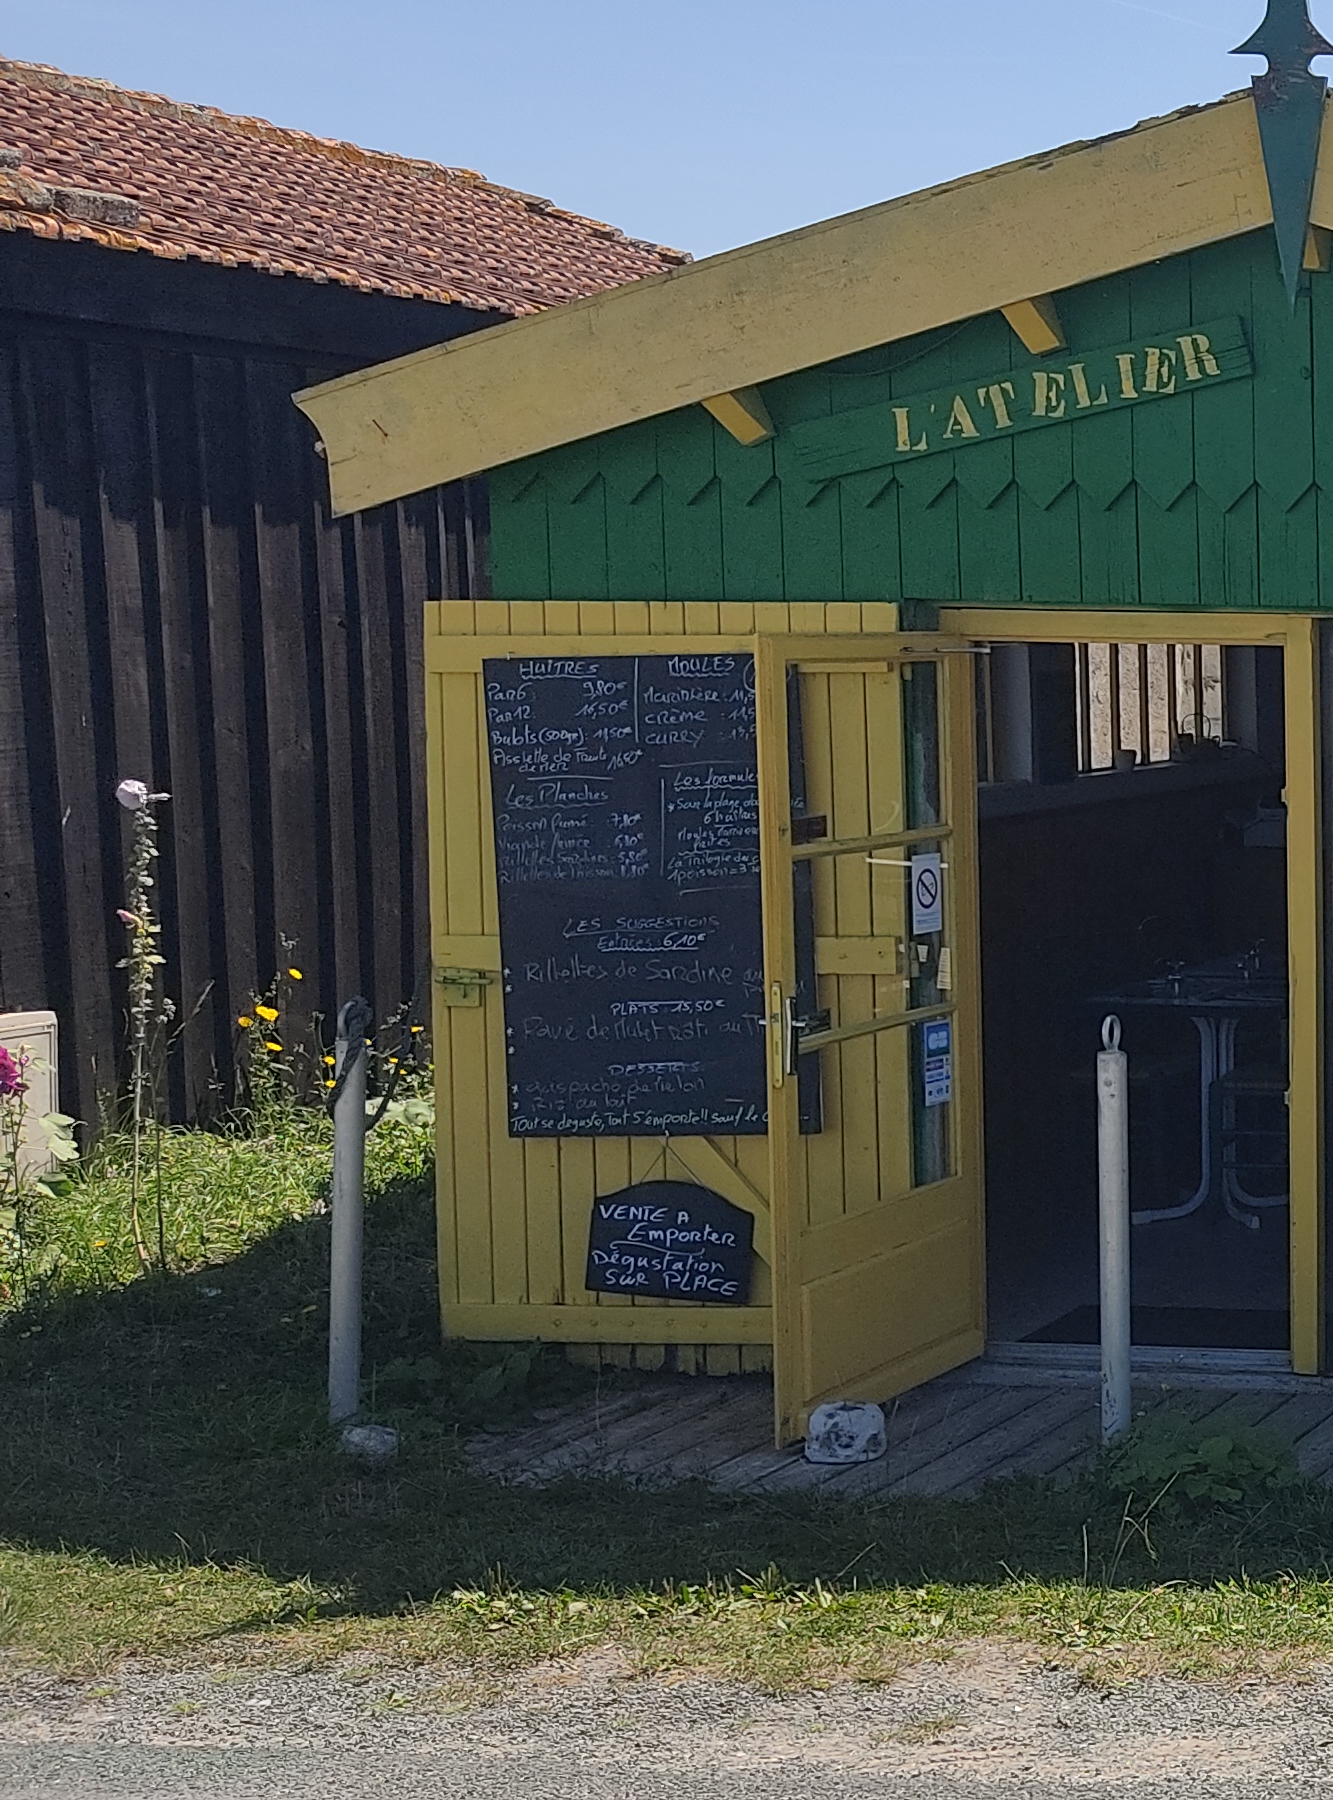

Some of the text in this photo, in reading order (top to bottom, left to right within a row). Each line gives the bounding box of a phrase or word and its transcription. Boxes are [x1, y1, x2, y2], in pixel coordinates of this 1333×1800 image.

[891, 334, 1221, 452] L'ATELIER
[553, 748, 572, 762] de
[673, 772, 700, 787] Les
[506, 781, 609, 806] Les Planches
[704, 811, 714, 824] 6
[563, 918, 600, 935] LES
[615, 960, 637, 978] de
[645, 959, 733, 985] Sardine
[599, 1204, 690, 1225] VENTE A
[663, 1271, 739, 1296] PLACE
